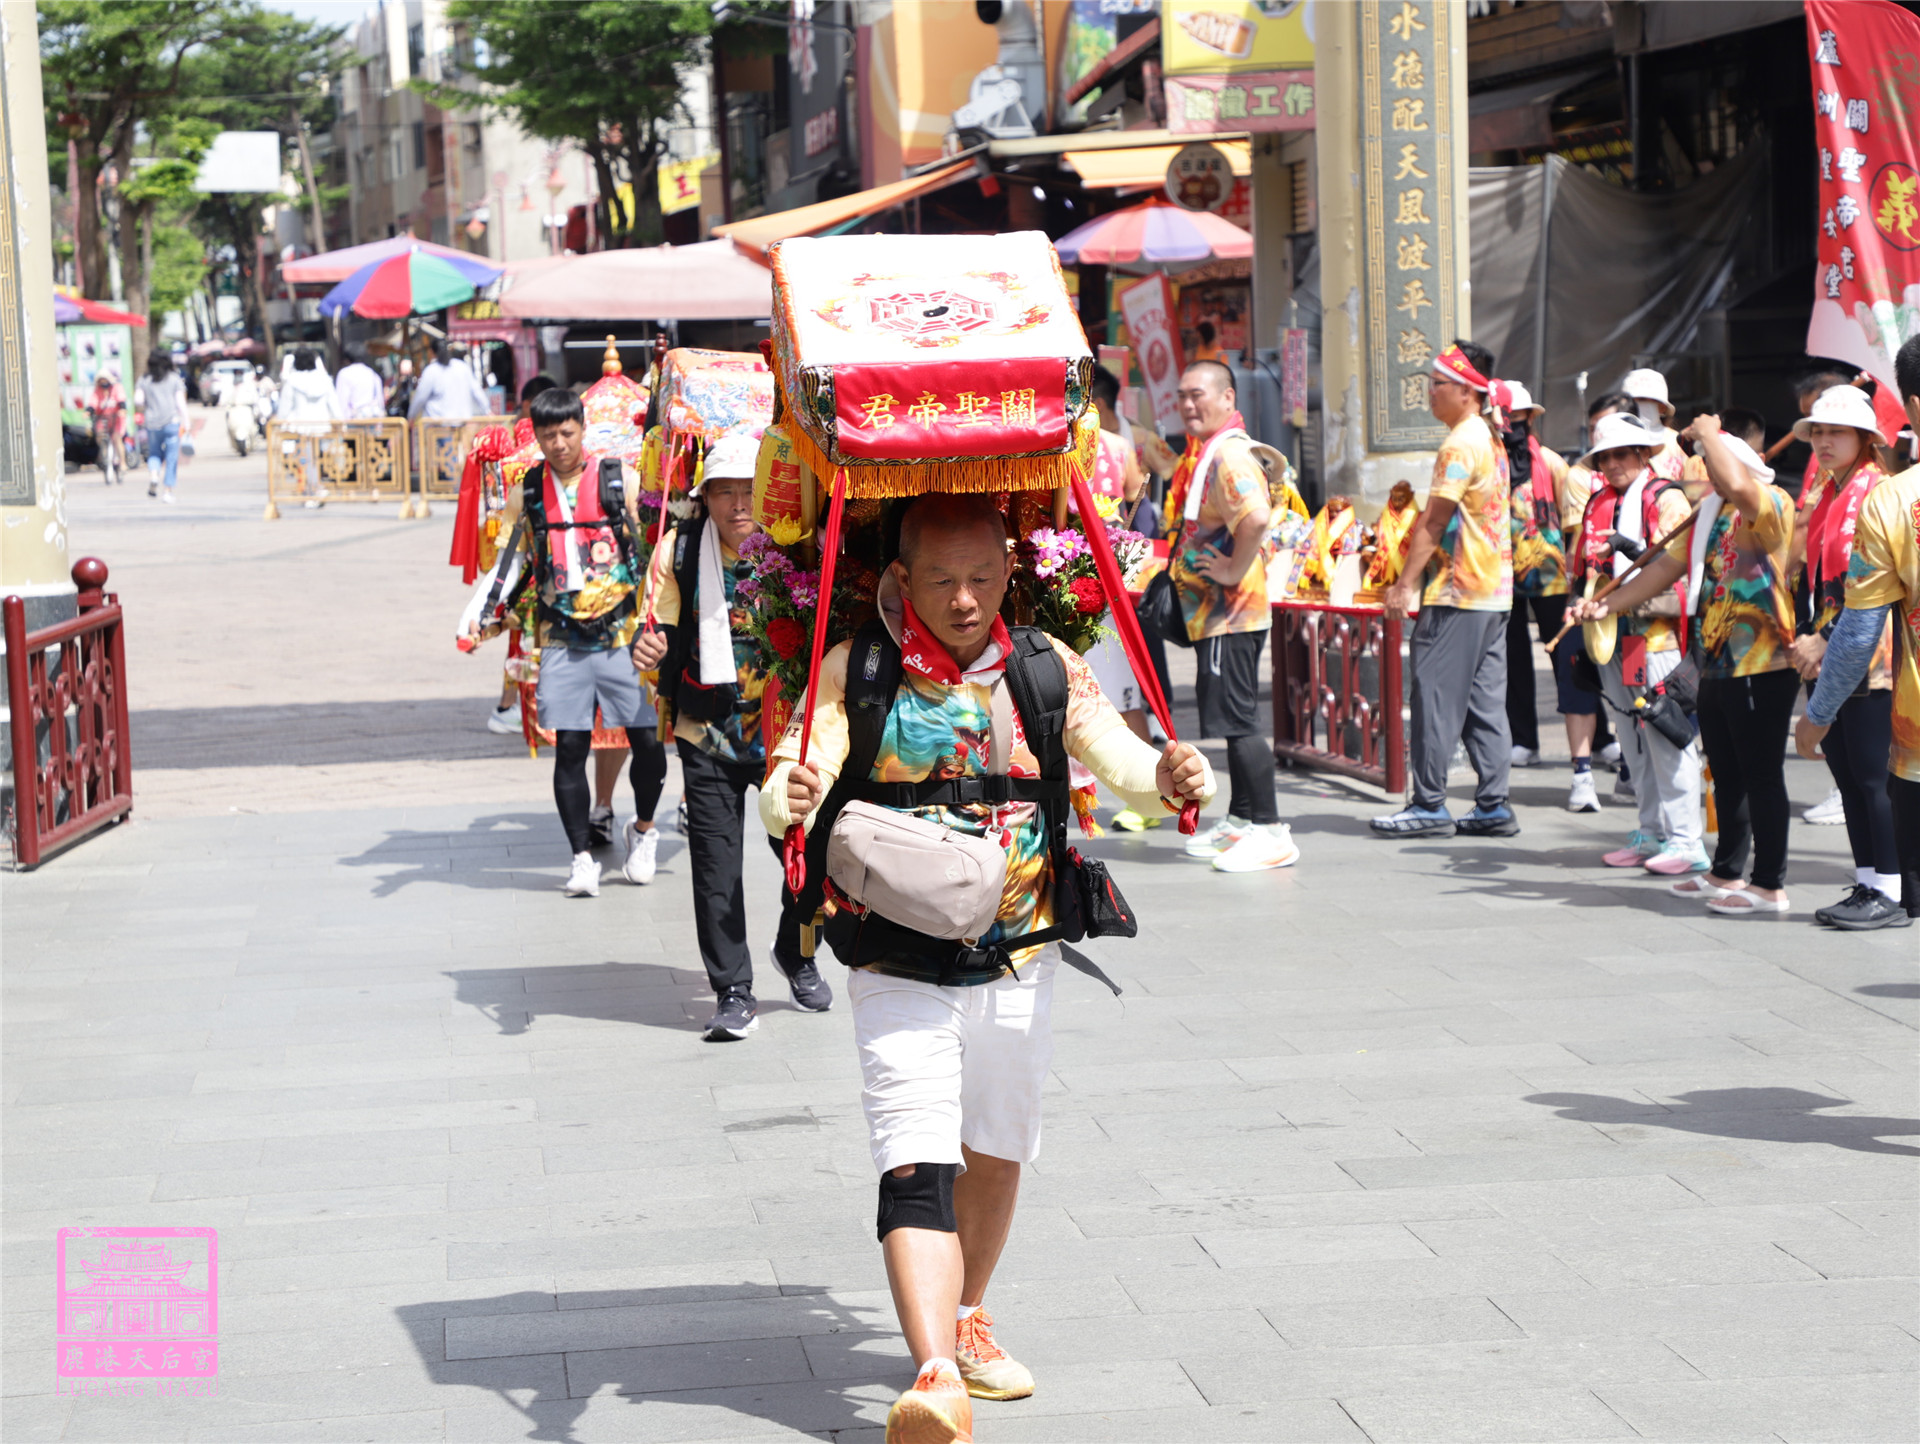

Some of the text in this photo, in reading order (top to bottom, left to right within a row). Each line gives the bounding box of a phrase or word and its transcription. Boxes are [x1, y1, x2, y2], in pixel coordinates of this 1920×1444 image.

[1388, 1, 1433, 411] 水德配天風波平海國
[1837, 98, 1868, 280] 關聖帝君
